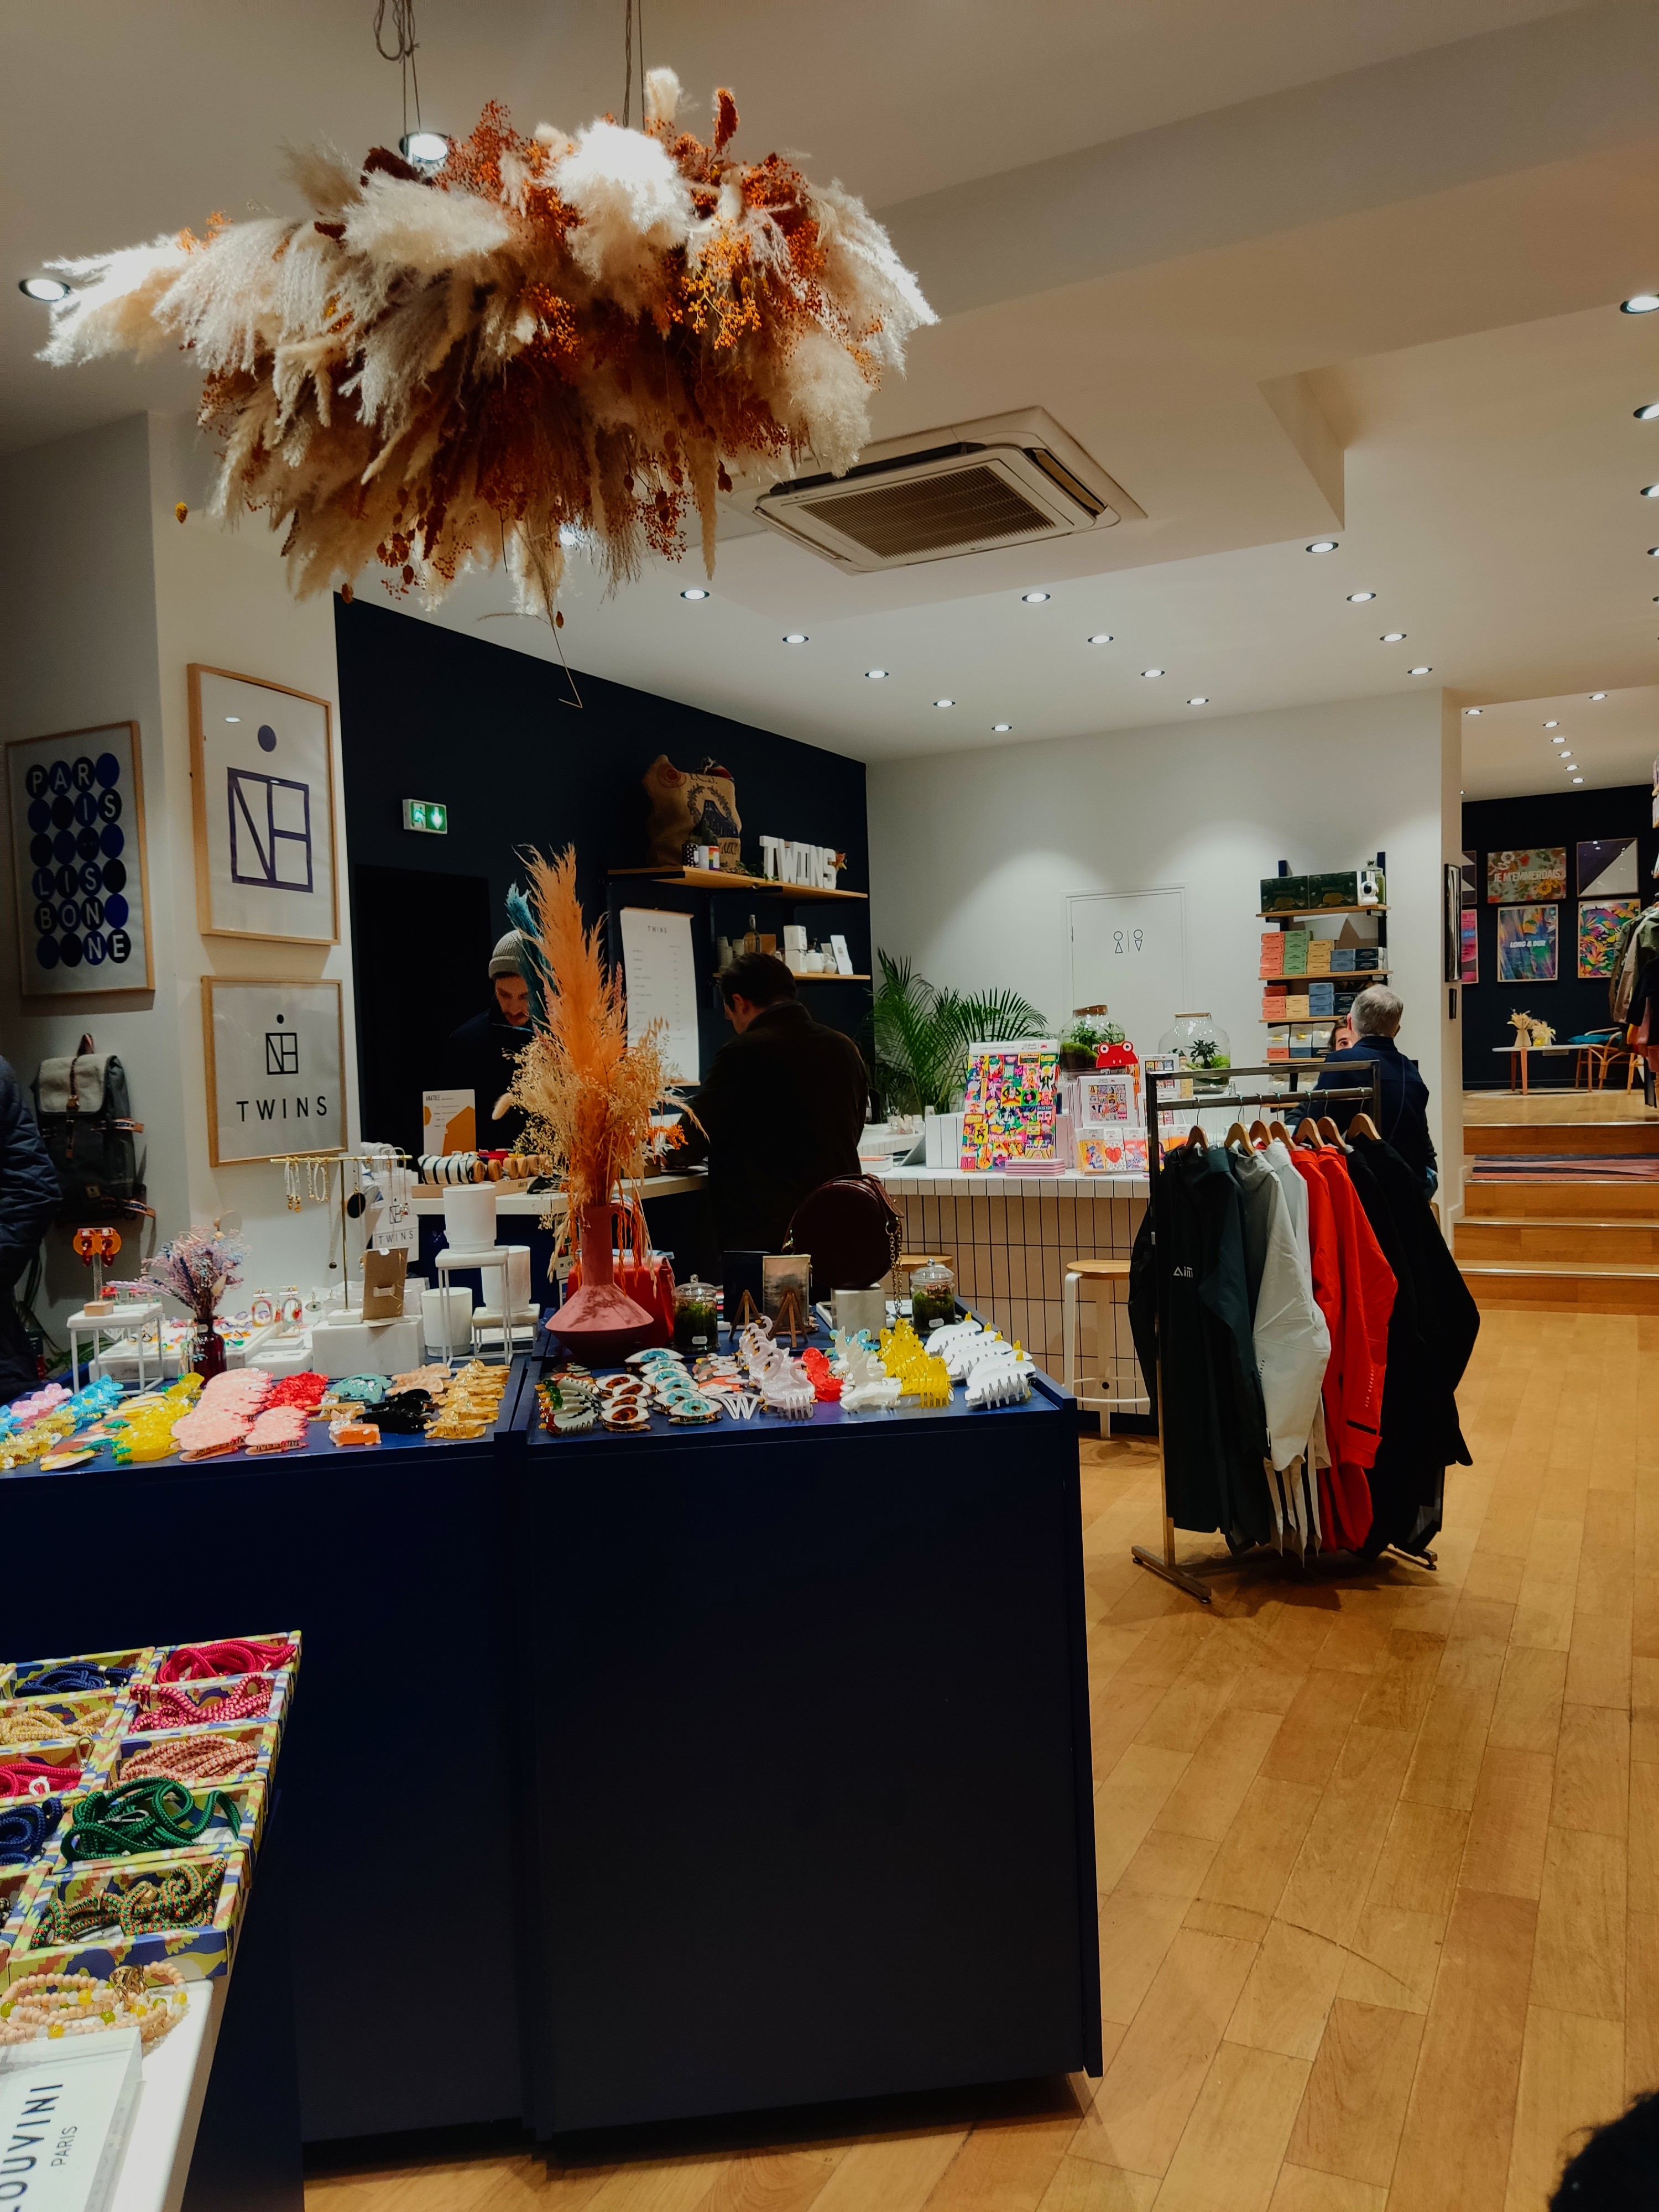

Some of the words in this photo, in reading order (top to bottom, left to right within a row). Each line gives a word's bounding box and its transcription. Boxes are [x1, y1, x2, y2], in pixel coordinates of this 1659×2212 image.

[759, 835, 837, 890] TWINS
[1494, 873, 1502, 882] JE
[648, 925, 667, 934] TWINS
[236, 1095, 327, 1122] TWINS
[378, 1230, 413, 1244] TWINS
[51, 2126, 77, 2167] PARIS
